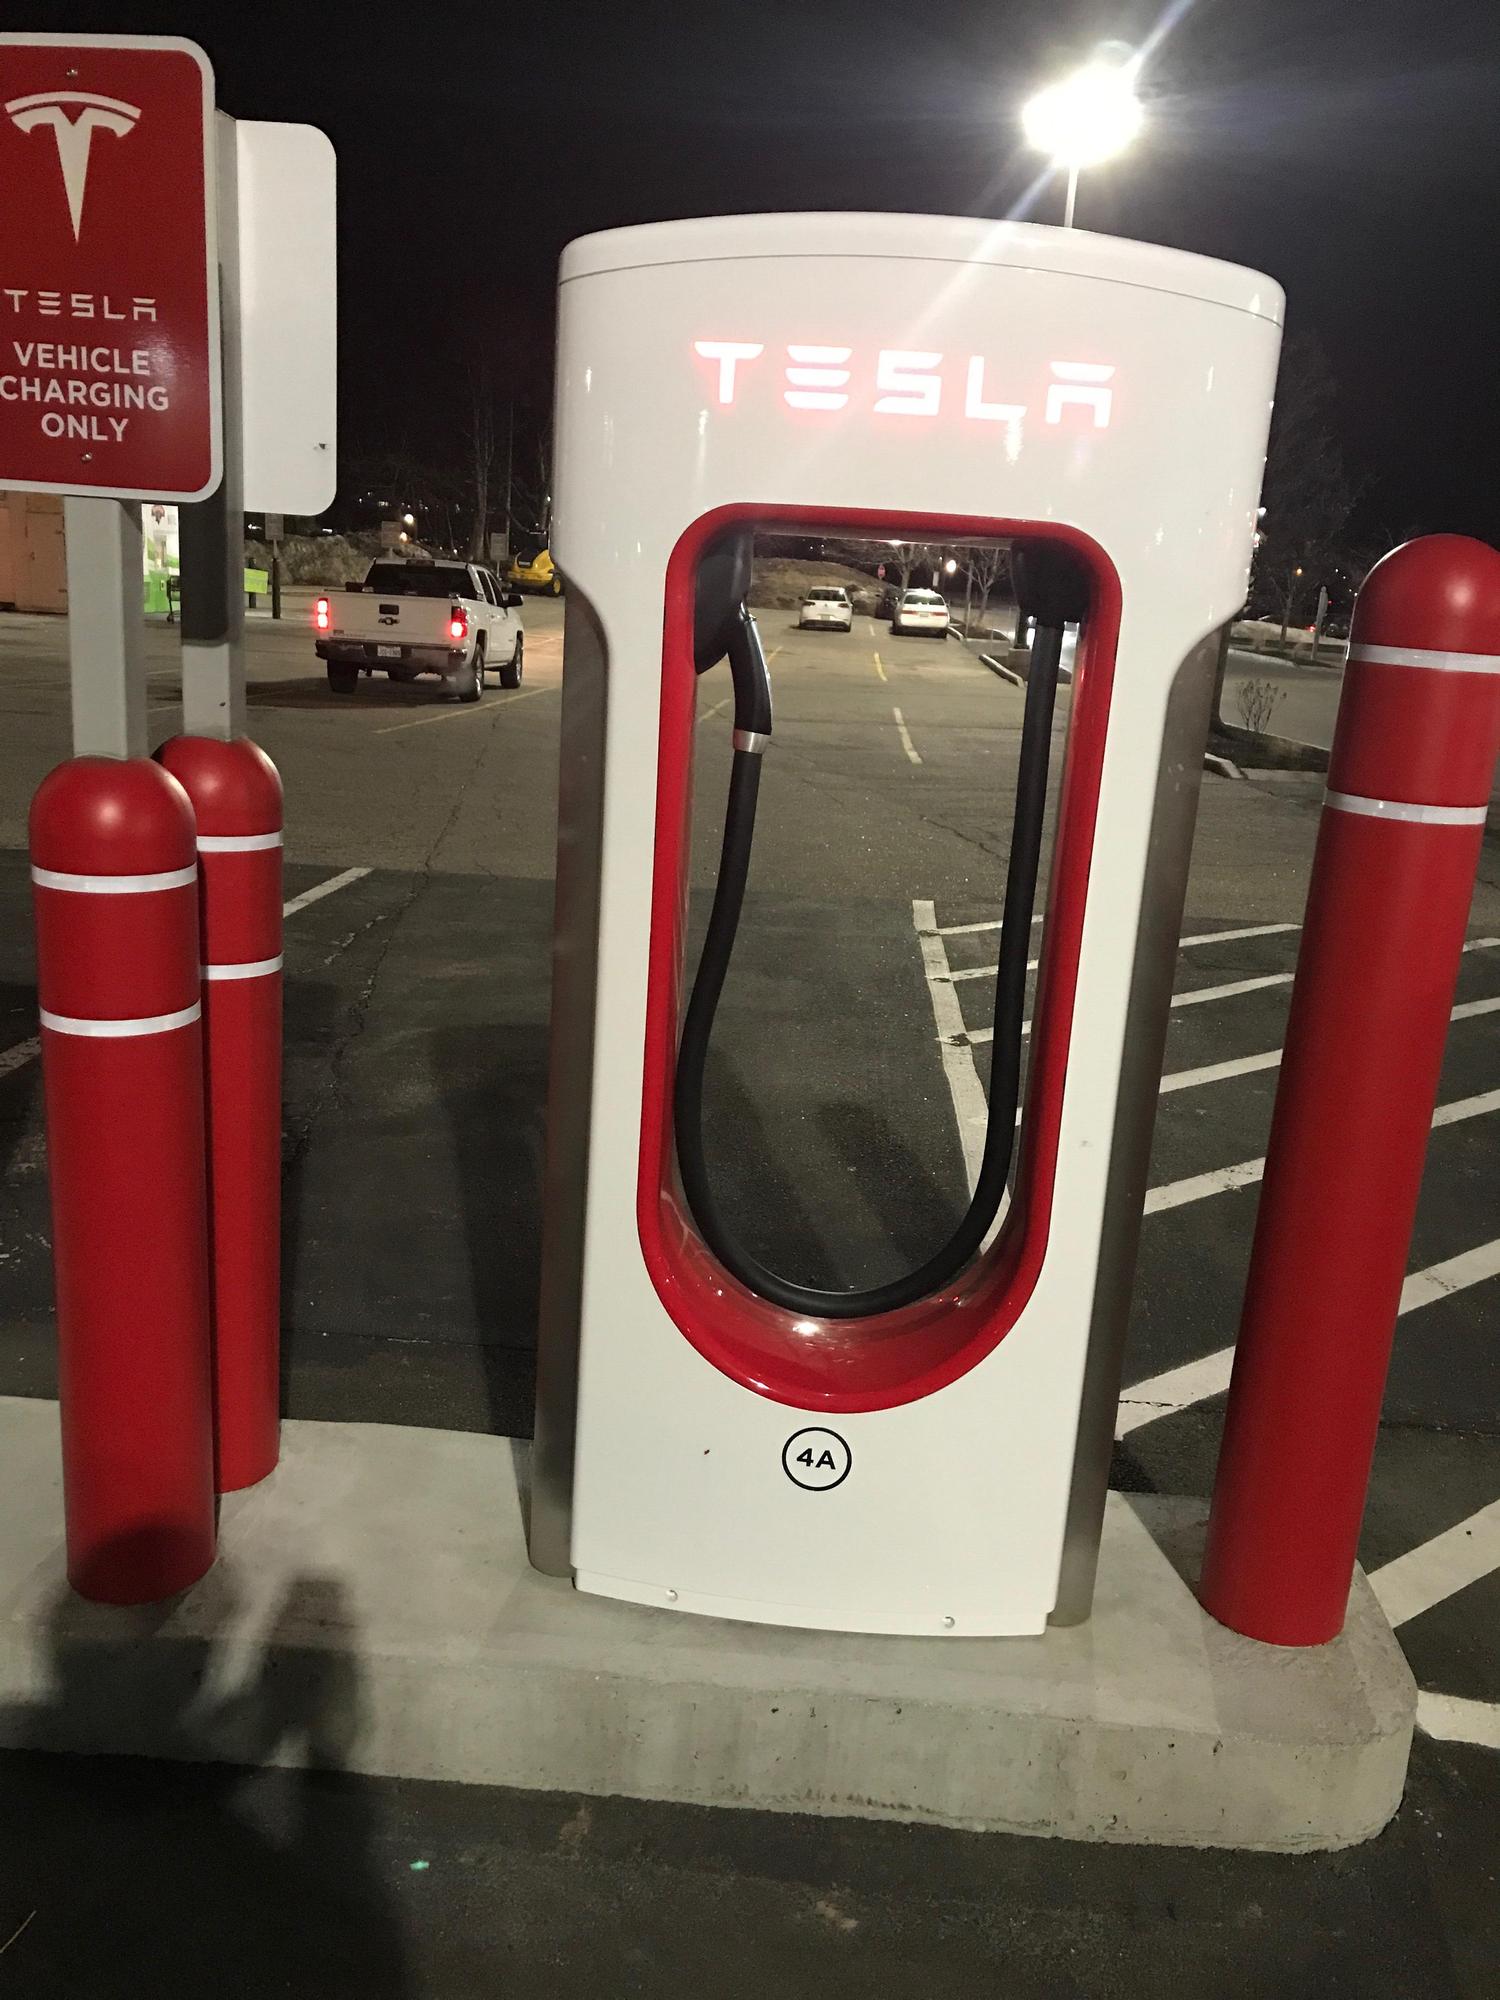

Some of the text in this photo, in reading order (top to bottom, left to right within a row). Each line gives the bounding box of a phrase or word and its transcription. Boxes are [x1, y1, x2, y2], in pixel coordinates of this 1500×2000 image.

[4, 289, 156, 321] TESLA
[13, 341, 150, 376] VEHICLE
[0, 375, 169, 411] CHARGING
[694, 341, 1116, 428] TESLA
[41, 412, 129, 442] ONLY
[796, 1448, 836, 1470] 4A
